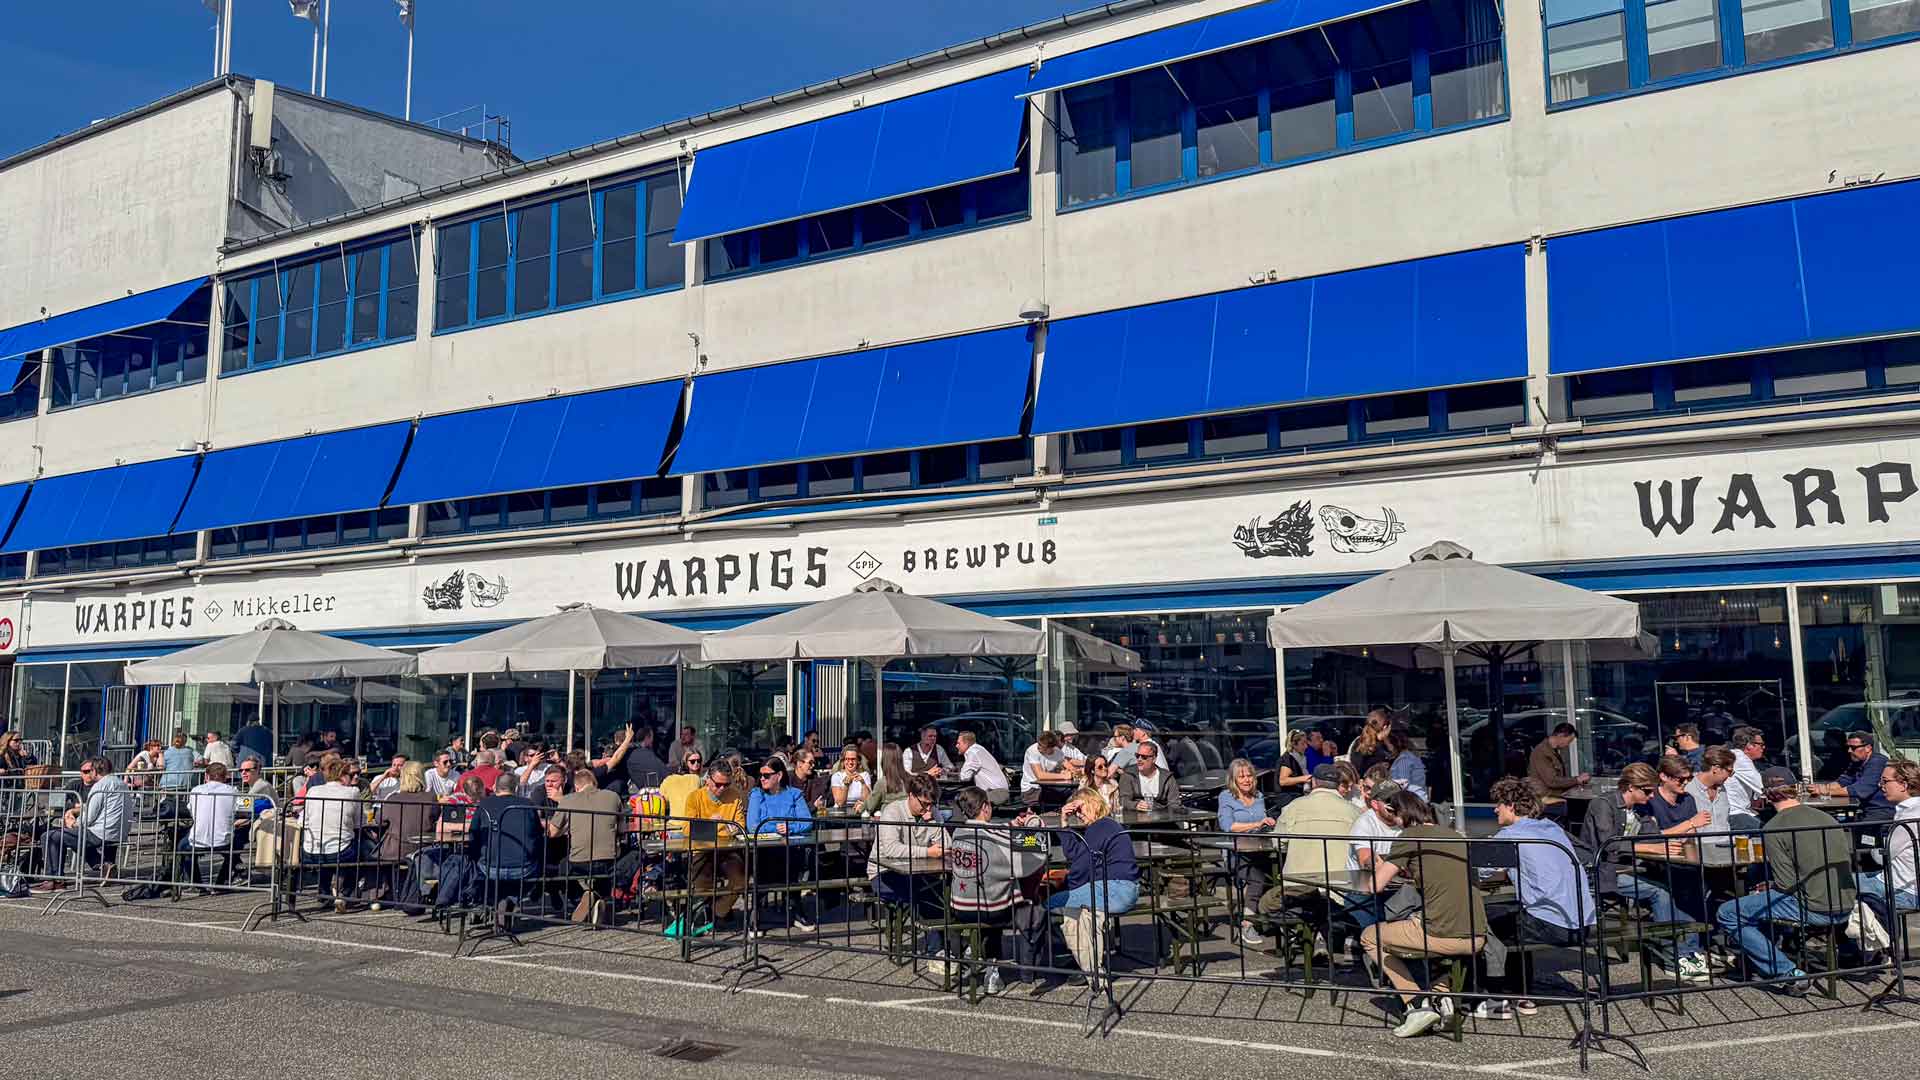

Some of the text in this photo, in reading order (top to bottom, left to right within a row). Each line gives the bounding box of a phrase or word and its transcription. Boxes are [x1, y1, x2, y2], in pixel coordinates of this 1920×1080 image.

[615, 539, 1057, 601] WARPIGS CPH BREWPUB
[75, 596, 195, 635] WARPIGS
[232, 593, 336, 618] Mikkeller
